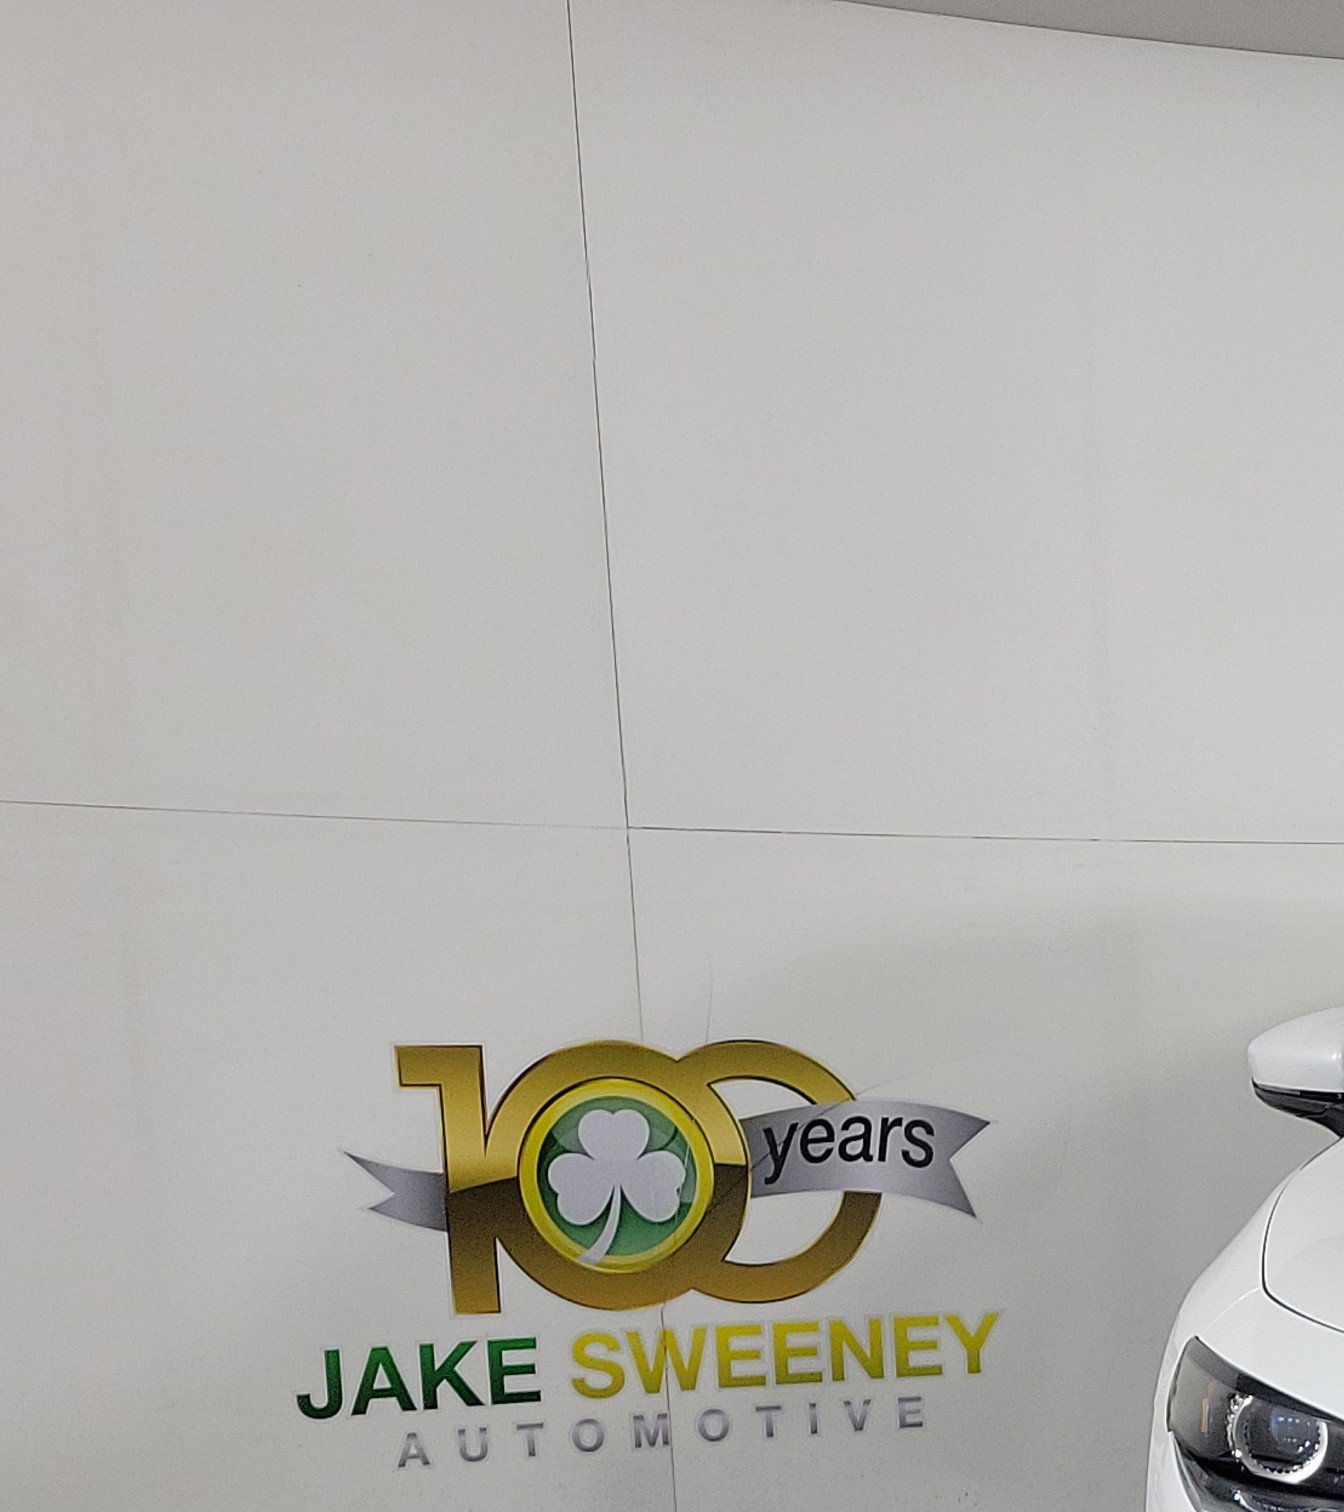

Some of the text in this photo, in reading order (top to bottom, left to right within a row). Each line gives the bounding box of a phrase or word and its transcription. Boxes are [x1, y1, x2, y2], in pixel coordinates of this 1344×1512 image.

[395, 1040, 935, 1314] 100 years
[297, 1311, 1001, 1420] JAKE SWEENEY
[398, 1396, 924, 1468] AUTOMOTIVE
